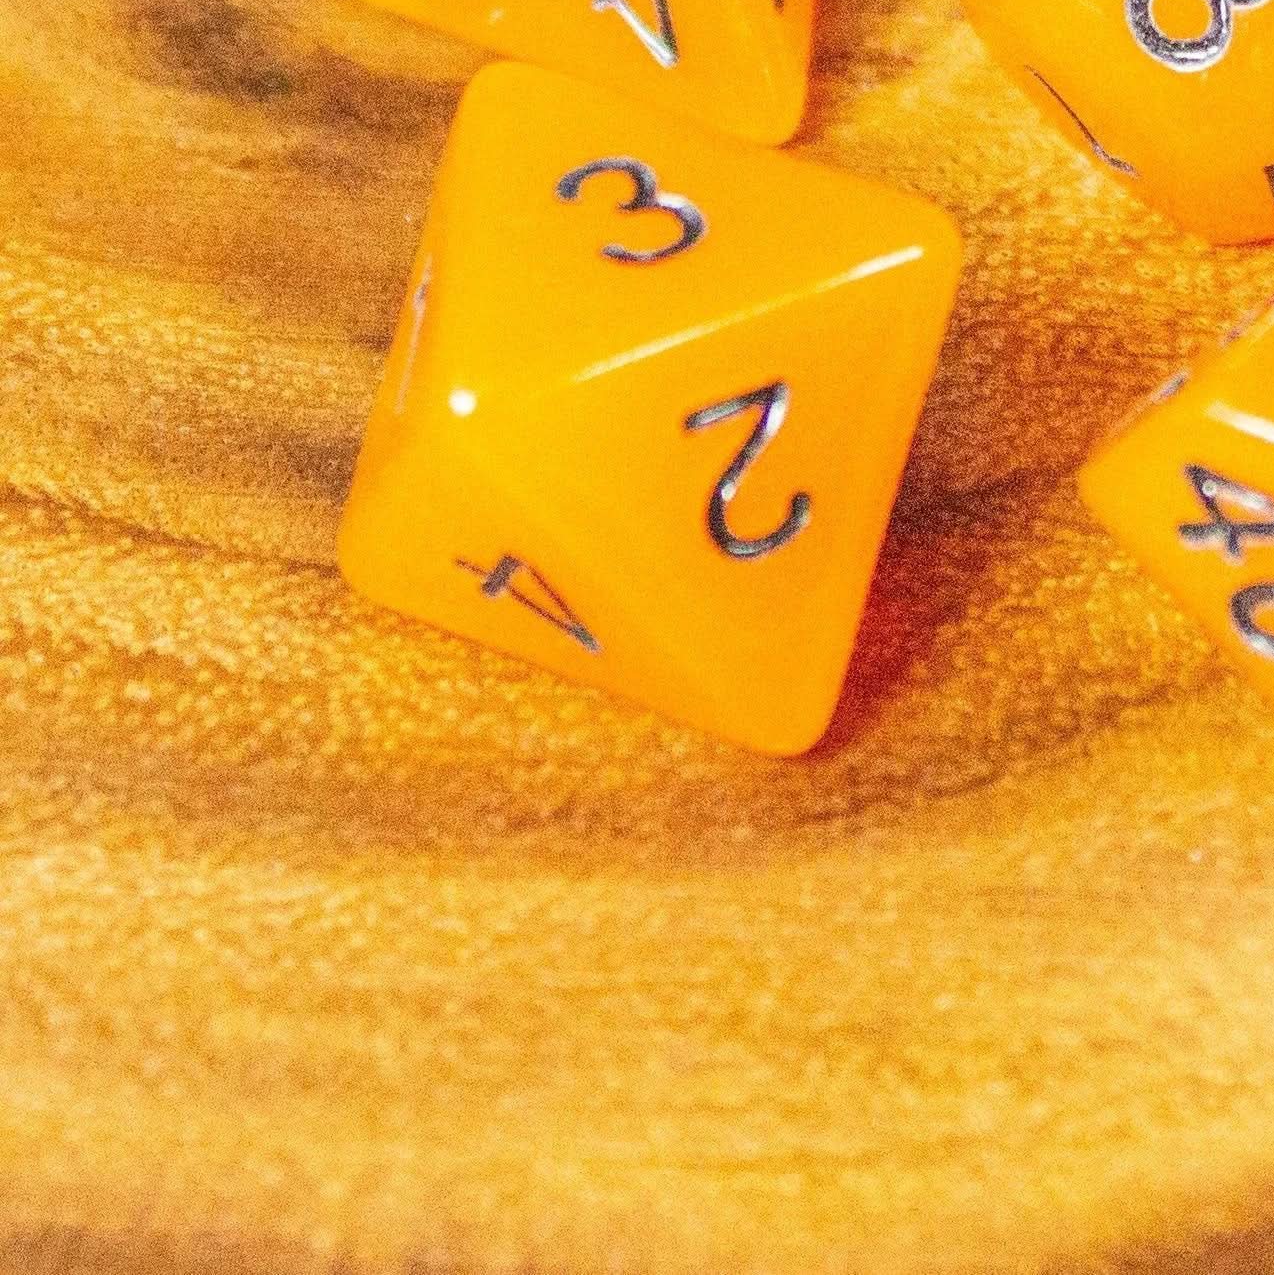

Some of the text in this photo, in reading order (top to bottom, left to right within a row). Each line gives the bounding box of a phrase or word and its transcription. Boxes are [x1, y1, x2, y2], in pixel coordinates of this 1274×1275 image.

[555, 156, 708, 262] 3
[683, 381, 812, 559] 2
[454, 553, 602, 654] 4
